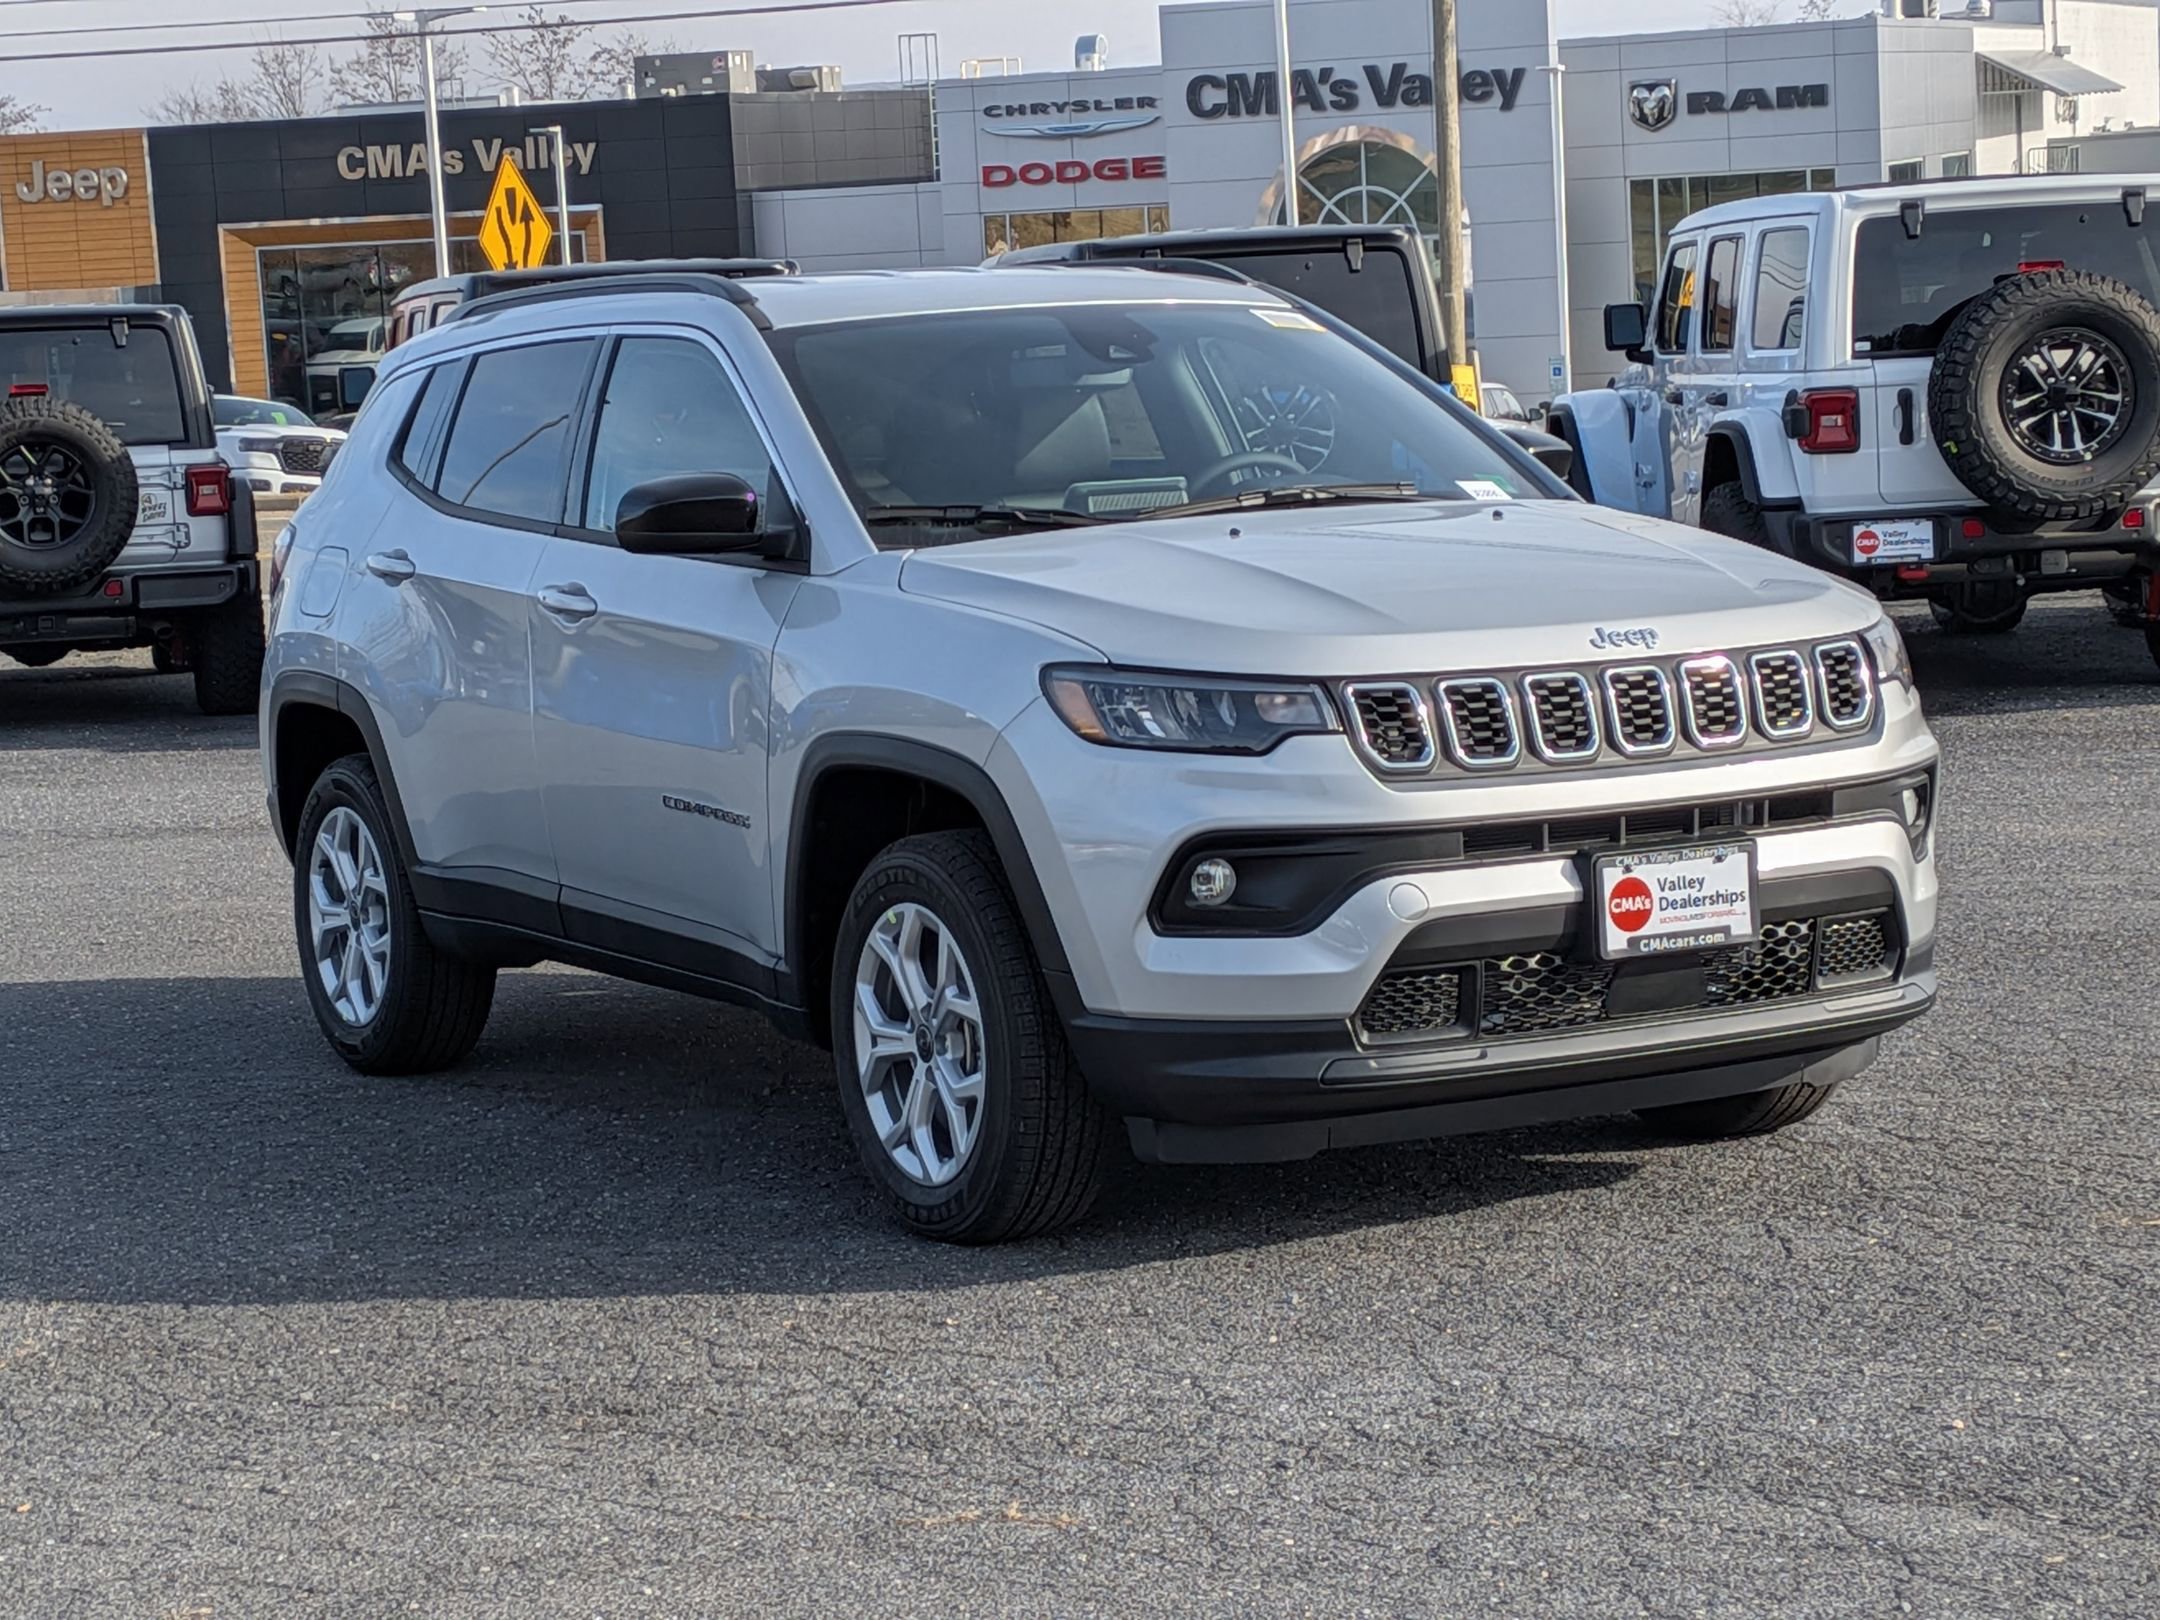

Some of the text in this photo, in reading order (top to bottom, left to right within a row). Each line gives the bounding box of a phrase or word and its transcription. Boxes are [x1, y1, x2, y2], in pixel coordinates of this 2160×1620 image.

[1185, 62, 1526, 118] CMA's Vaey
[1686, 84, 1829, 115] RAM
[983, 96, 1159, 118] CHRYSLER
[337, 143, 464, 180] CMAs
[982, 156, 1166, 187] DODGE
[16, 160, 128, 206] Jeep
[1589, 627, 1659, 649] Jeep
[1657, 875, 1705, 892] Valley
[1611, 896, 1651, 913] CMA's
[1659, 889, 1746, 912] Dealerships
[1640, 932, 1725, 951] CMAcars.com
